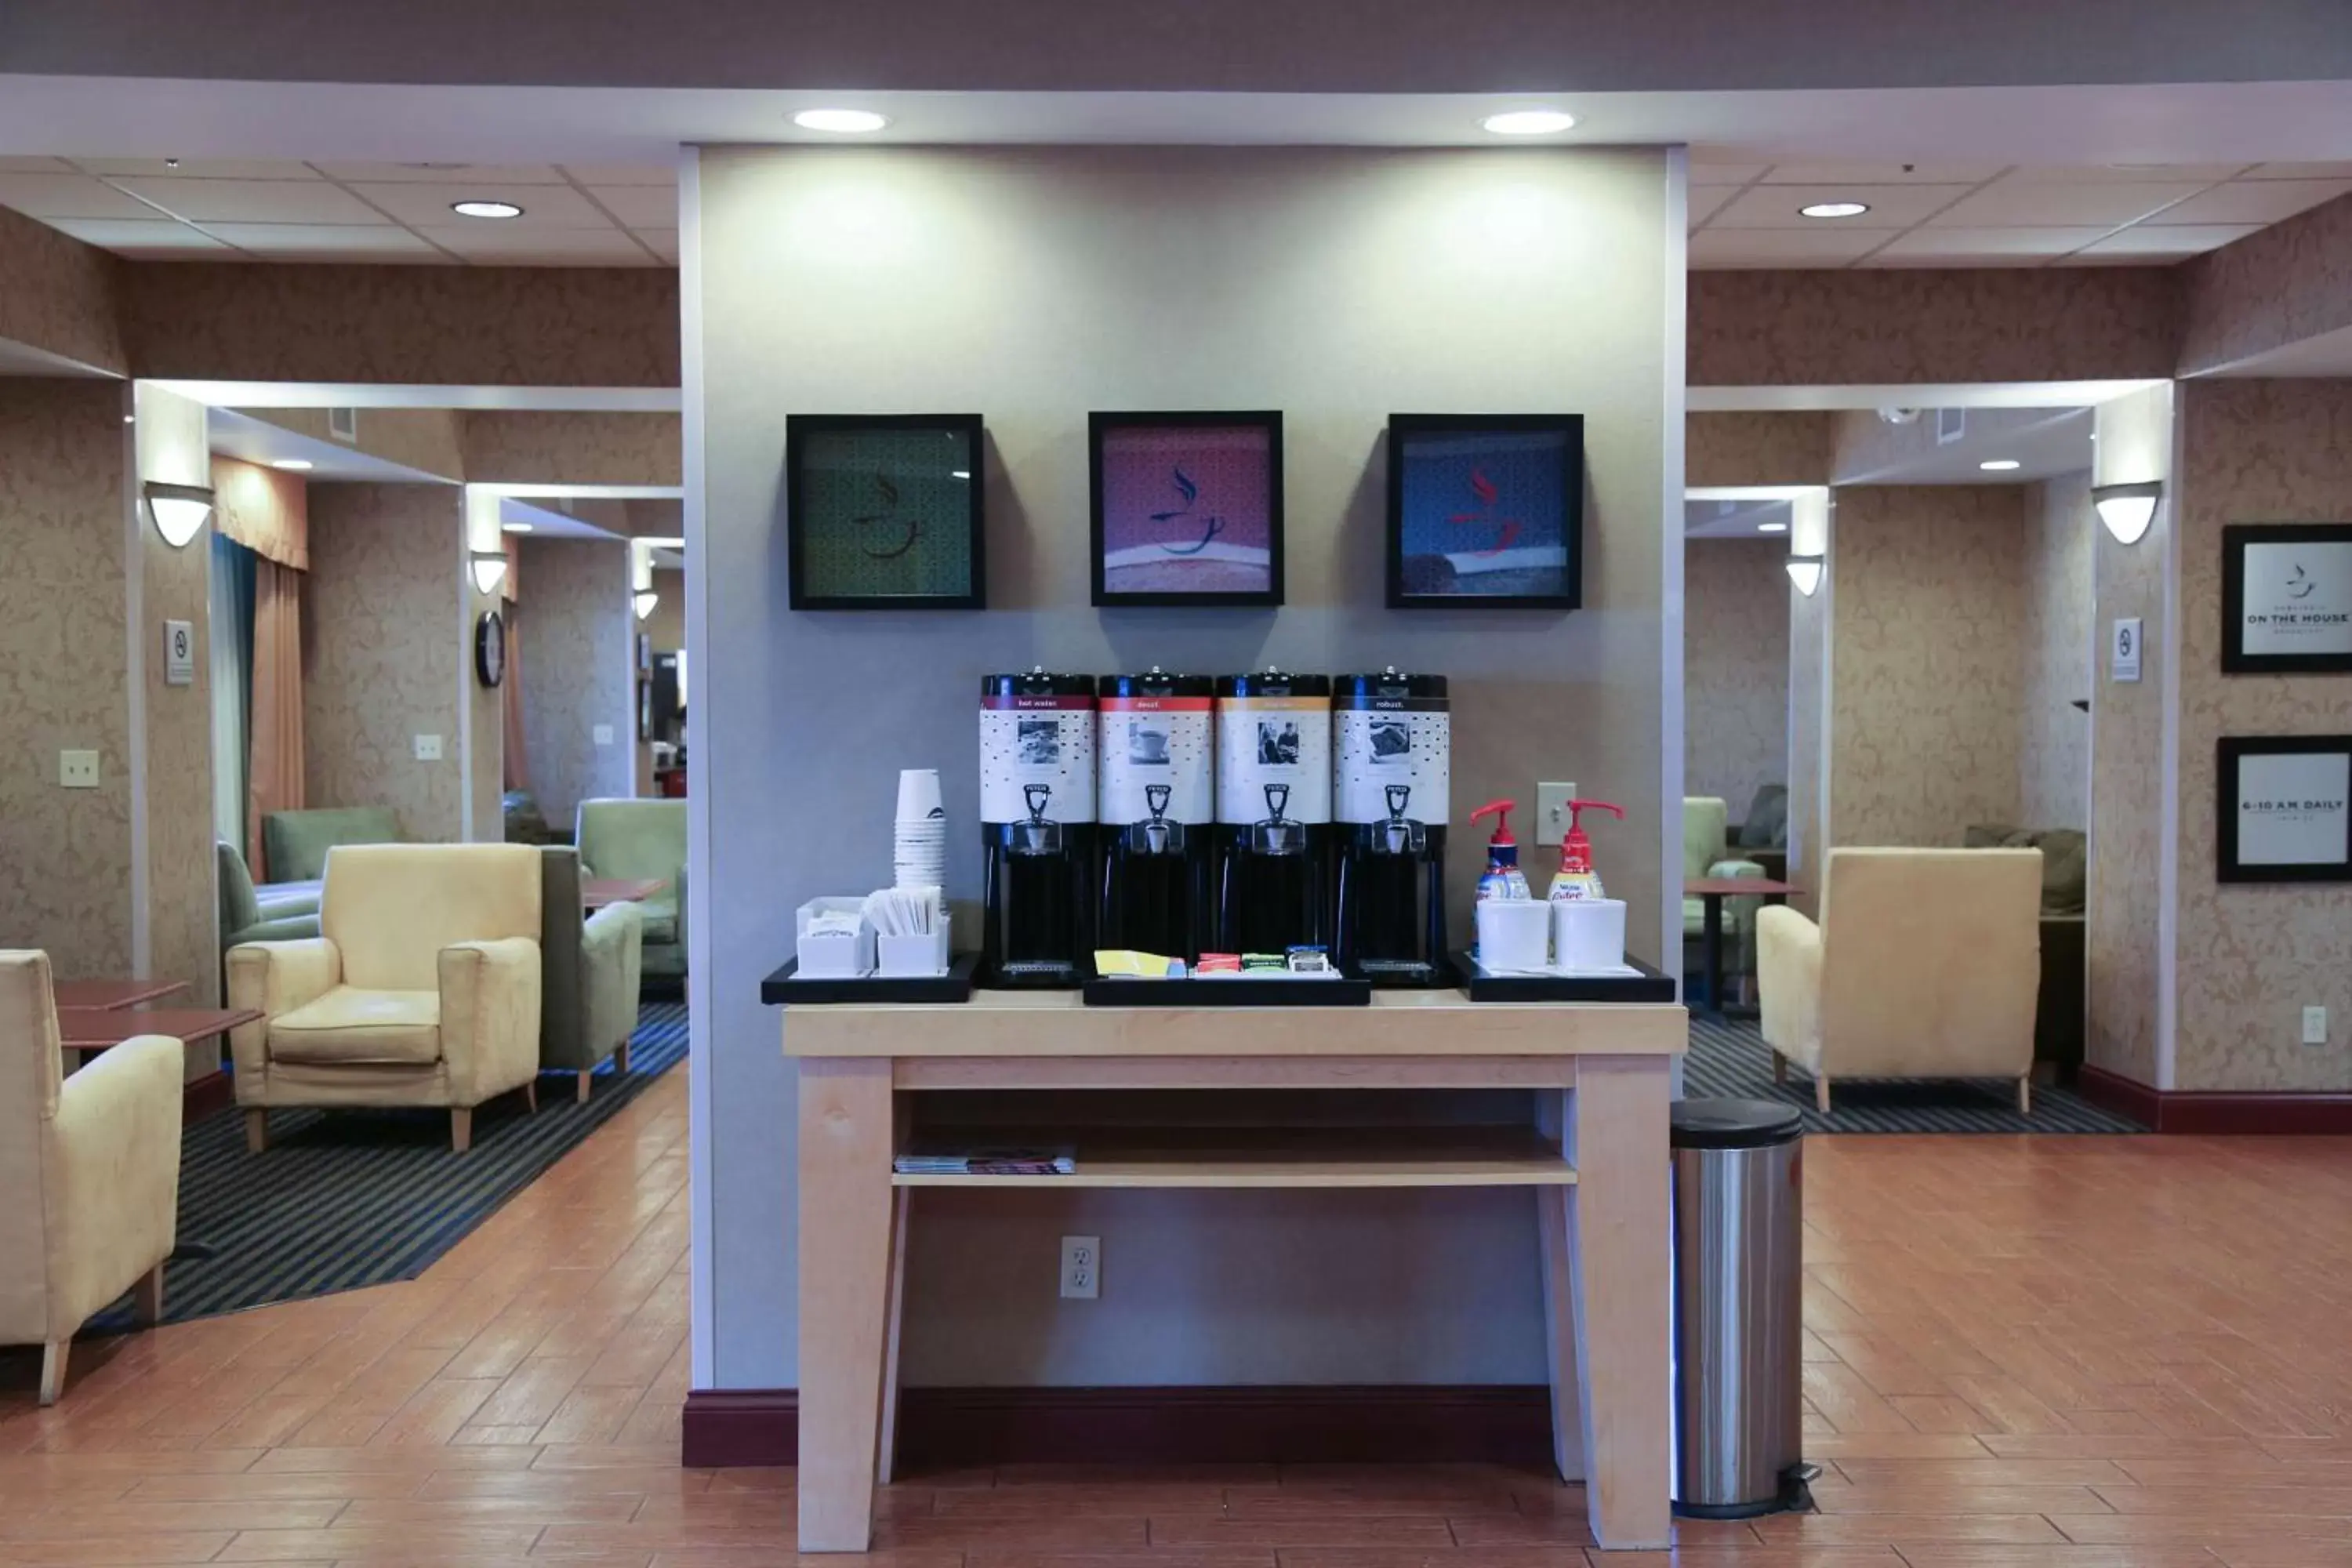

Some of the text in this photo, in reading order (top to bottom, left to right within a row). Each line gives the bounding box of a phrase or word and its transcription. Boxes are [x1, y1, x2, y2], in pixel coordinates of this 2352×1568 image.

[2247, 613, 2350, 624] ON THE HOUSE
[2303, 800, 2343, 810] DAILY
